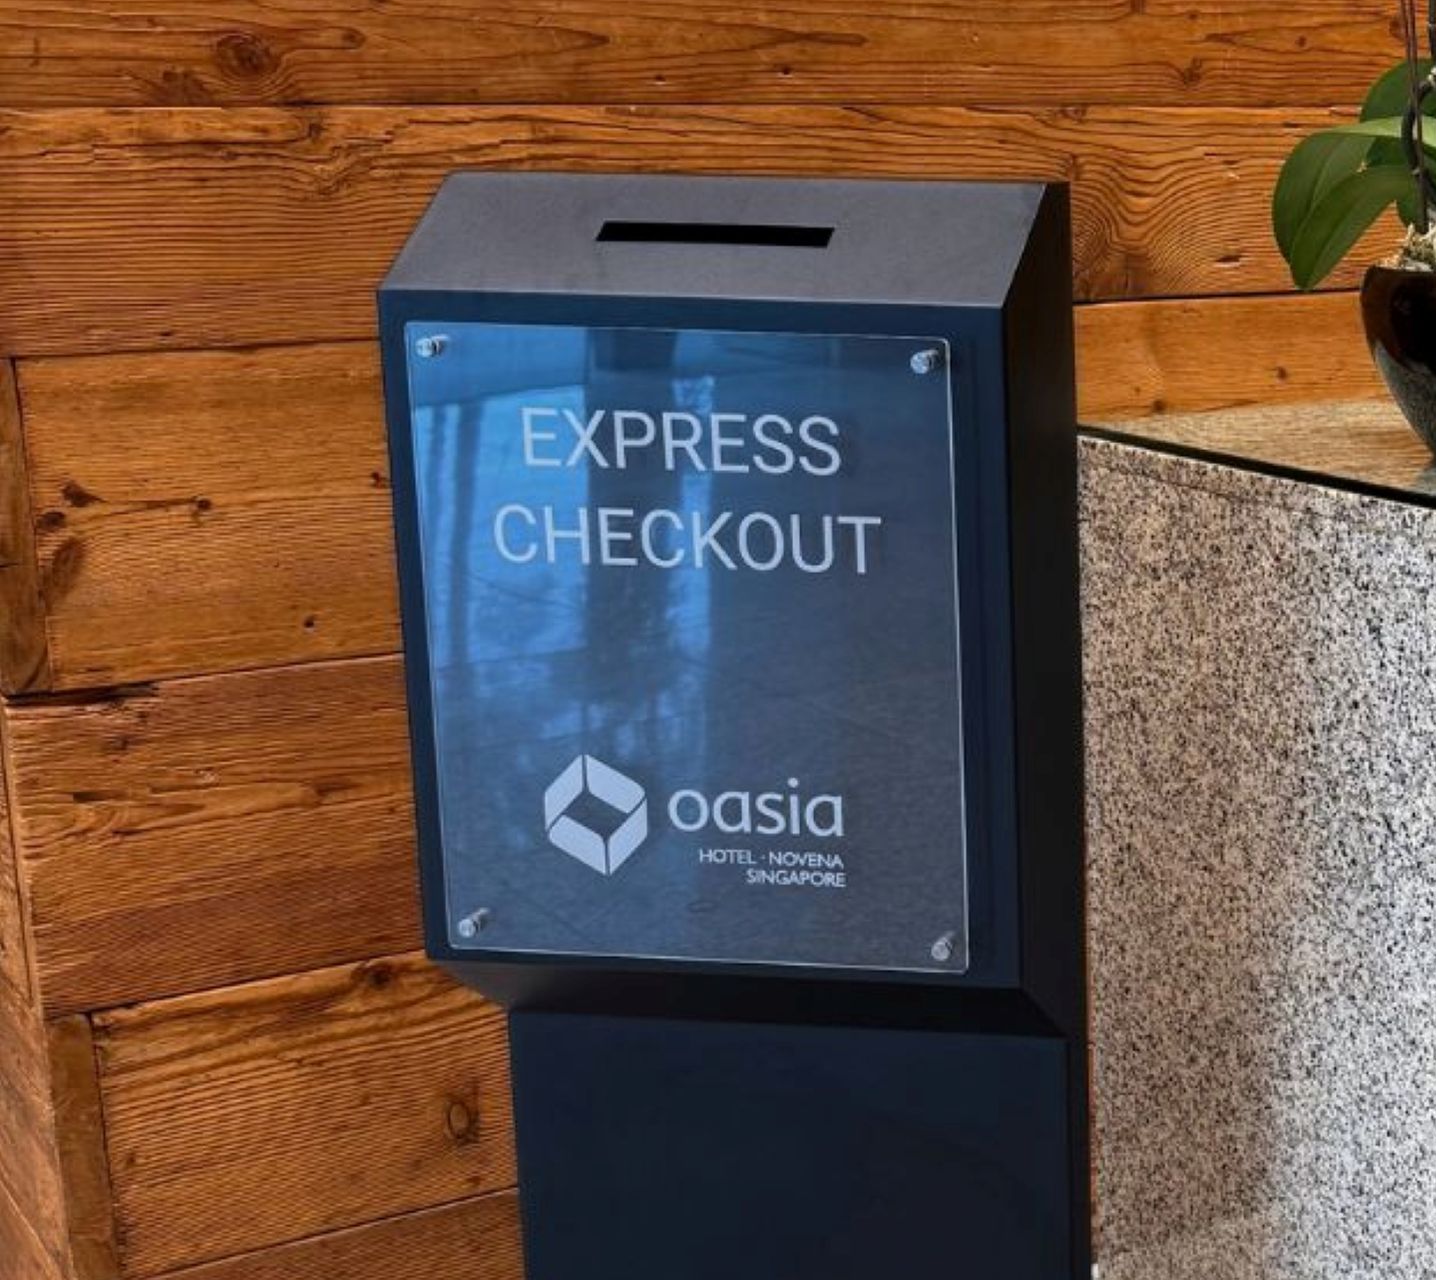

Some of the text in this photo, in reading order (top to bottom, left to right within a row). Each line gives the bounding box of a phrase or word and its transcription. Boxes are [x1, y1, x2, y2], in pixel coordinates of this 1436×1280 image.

[521, 406, 843, 477] EXPRESS
[493, 503, 882, 575] CHECKOUT
[667, 777, 845, 837] oasia
[699, 848, 845, 869] HOTEL NOVENA
[746, 868, 847, 888] SINGAPORE
